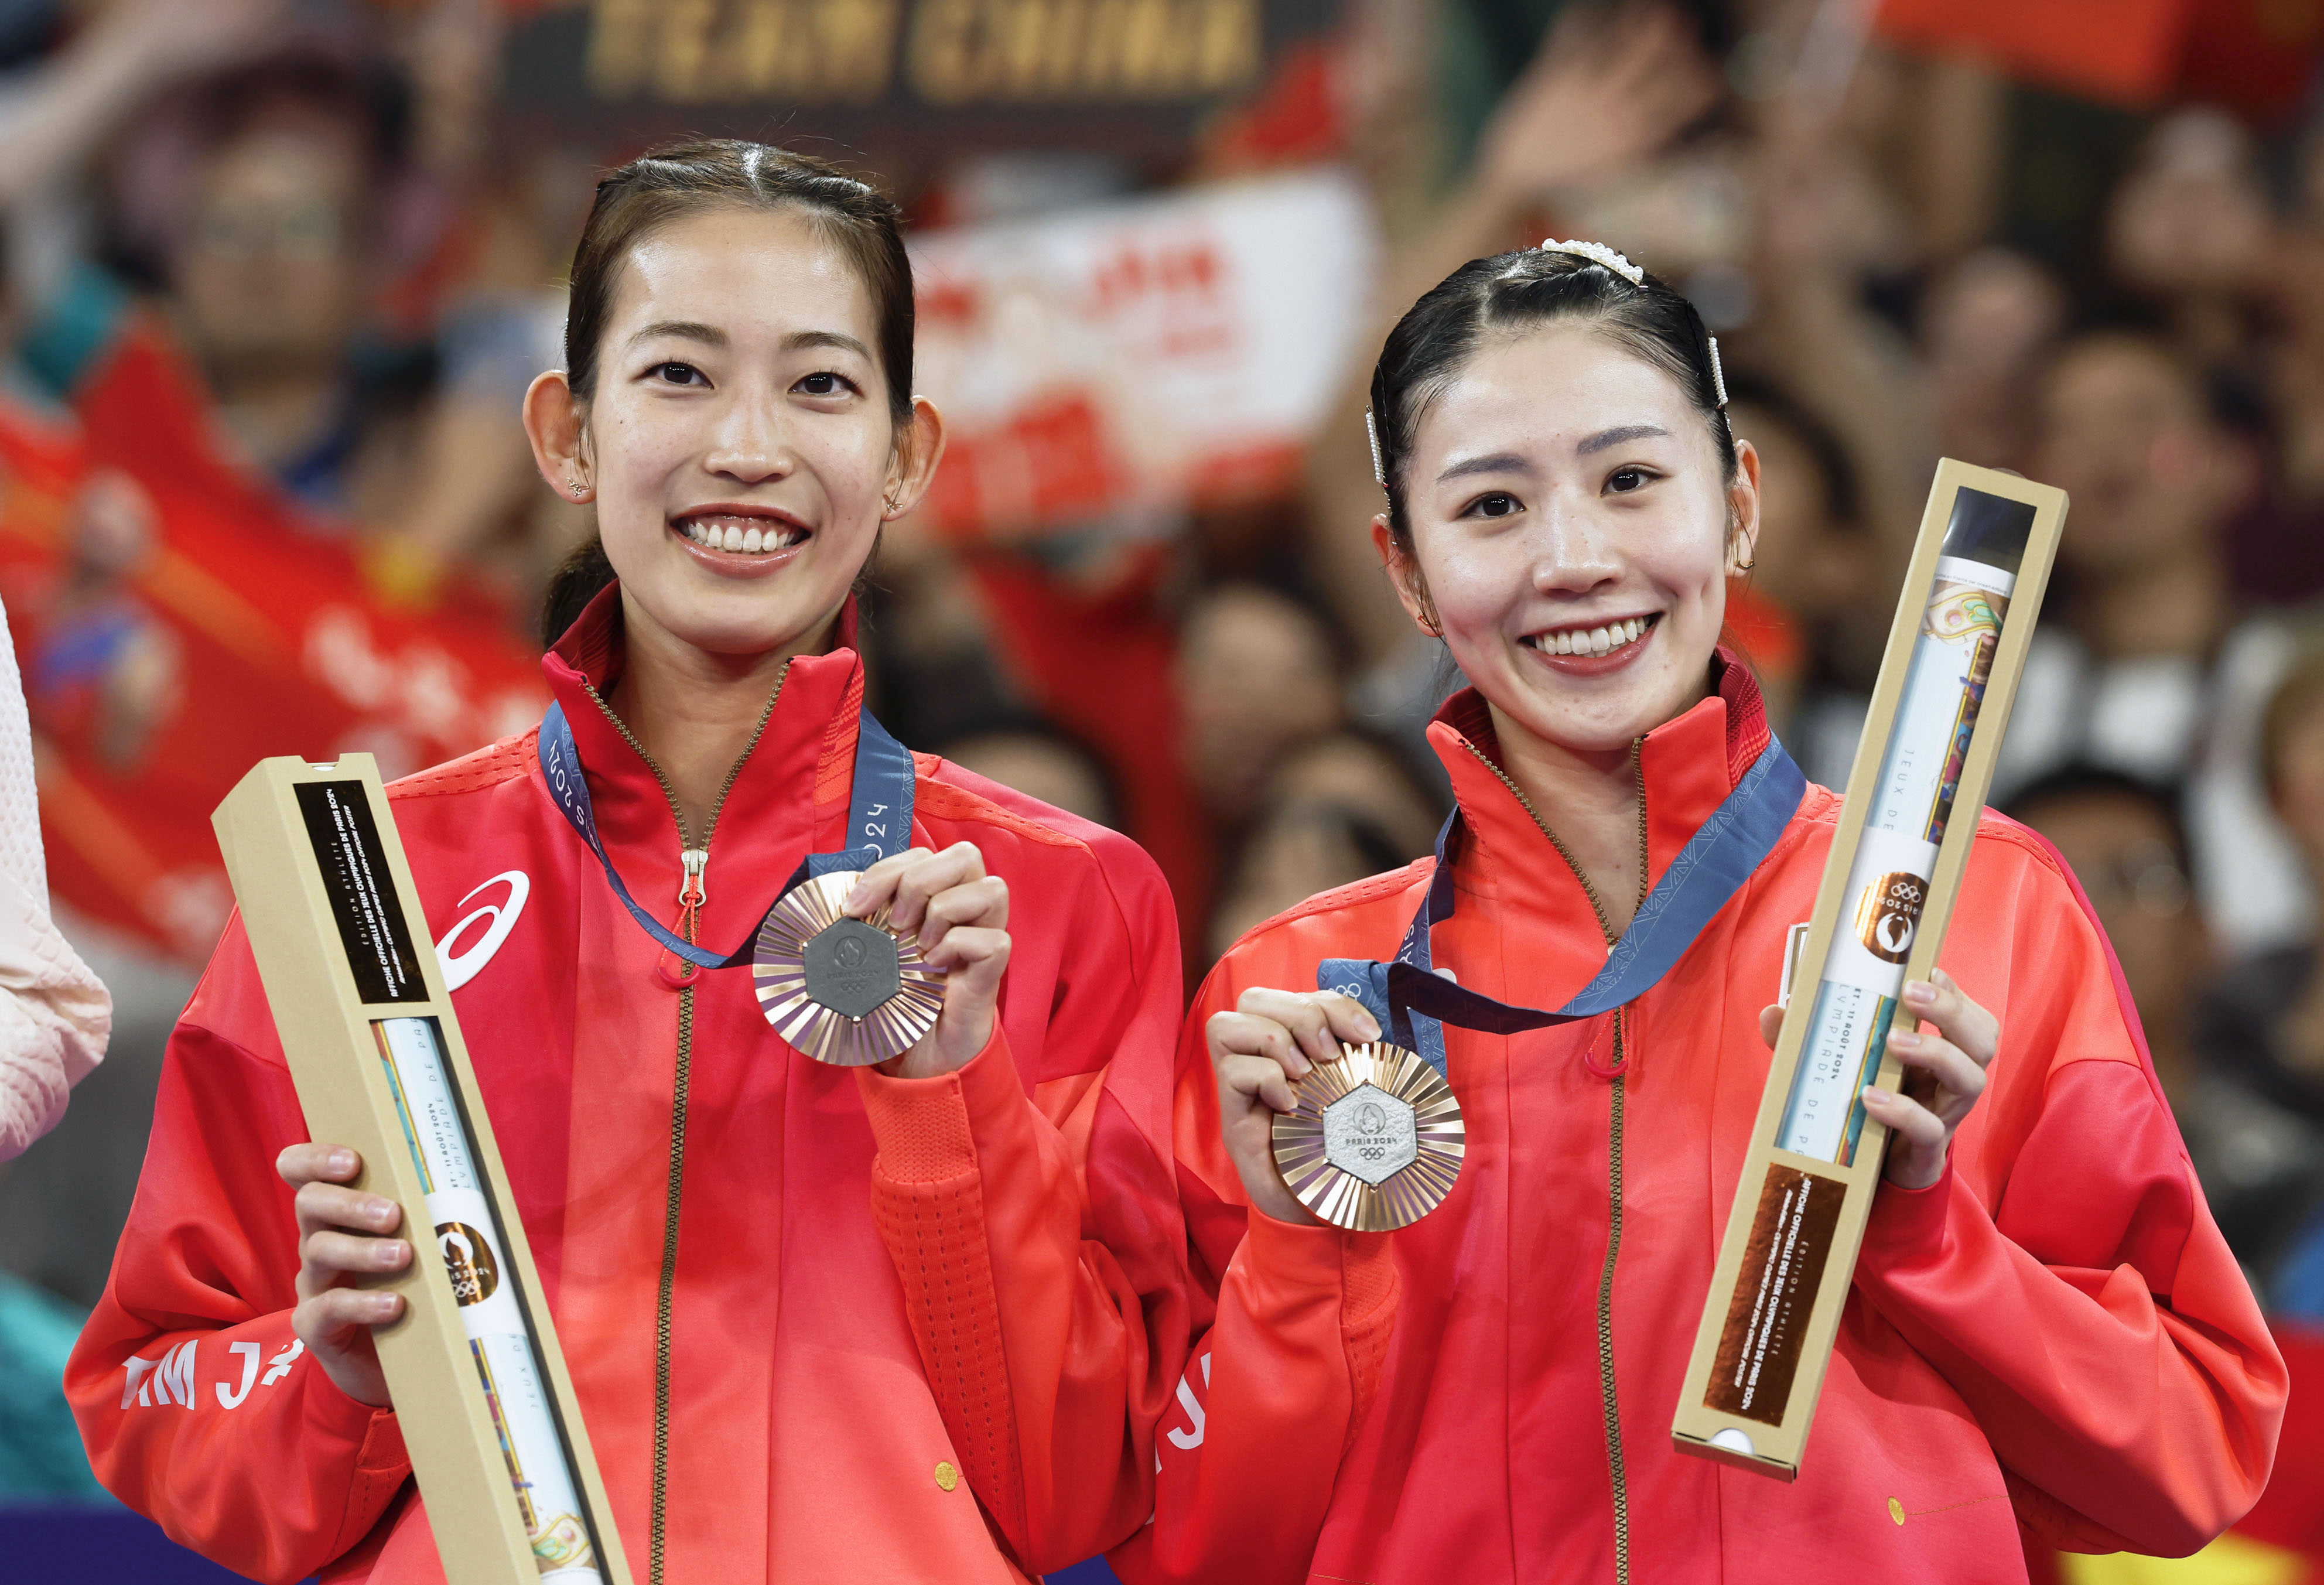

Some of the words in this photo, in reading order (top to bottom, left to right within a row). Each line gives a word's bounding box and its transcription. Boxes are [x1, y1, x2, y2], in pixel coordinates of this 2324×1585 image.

[548, 739, 573, 808] 2024
[1894, 750, 1915, 795] JEUX
[326, 788, 339, 809] 2024
[332, 809, 346, 832] PARIS
[343, 805, 357, 830] POSTER
[1884, 809, 1898, 831] DE
[339, 832, 349, 842] DE
[343, 842, 364, 891] OLYMPIQUES
[358, 891, 371, 909] JEUX
[364, 909, 375, 924] DES
[368, 924, 388, 965] OFFICIELLE
[382, 966, 399, 997] AFFICHE
[1813, 983, 1850, 1084] LYMPIADE
[1839, 1023, 1852, 1049] AOÛT
[424, 1064, 437, 1082] DE
[1830, 1054, 1844, 1080] 2024
[428, 1103, 439, 1127] 2024
[1804, 1099, 1819, 1120] DE
[435, 1098, 470, 1188] LYMPIADE
[435, 1132, 448, 1156] AOÛT
[1795, 1178, 1812, 1215] AFFICHE
[1782, 1214, 1802, 1261] OFFICIELLE
[1778, 1260, 1790, 1277] DES
[1772, 1276, 1785, 1296] JEUX
[1757, 1296, 1779, 1350] OLYMPIQUES
[1754, 1350, 1765, 1362] DE
[1747, 1361, 1762, 1386] PARIS
[1741, 1386, 1755, 1410] 2024
